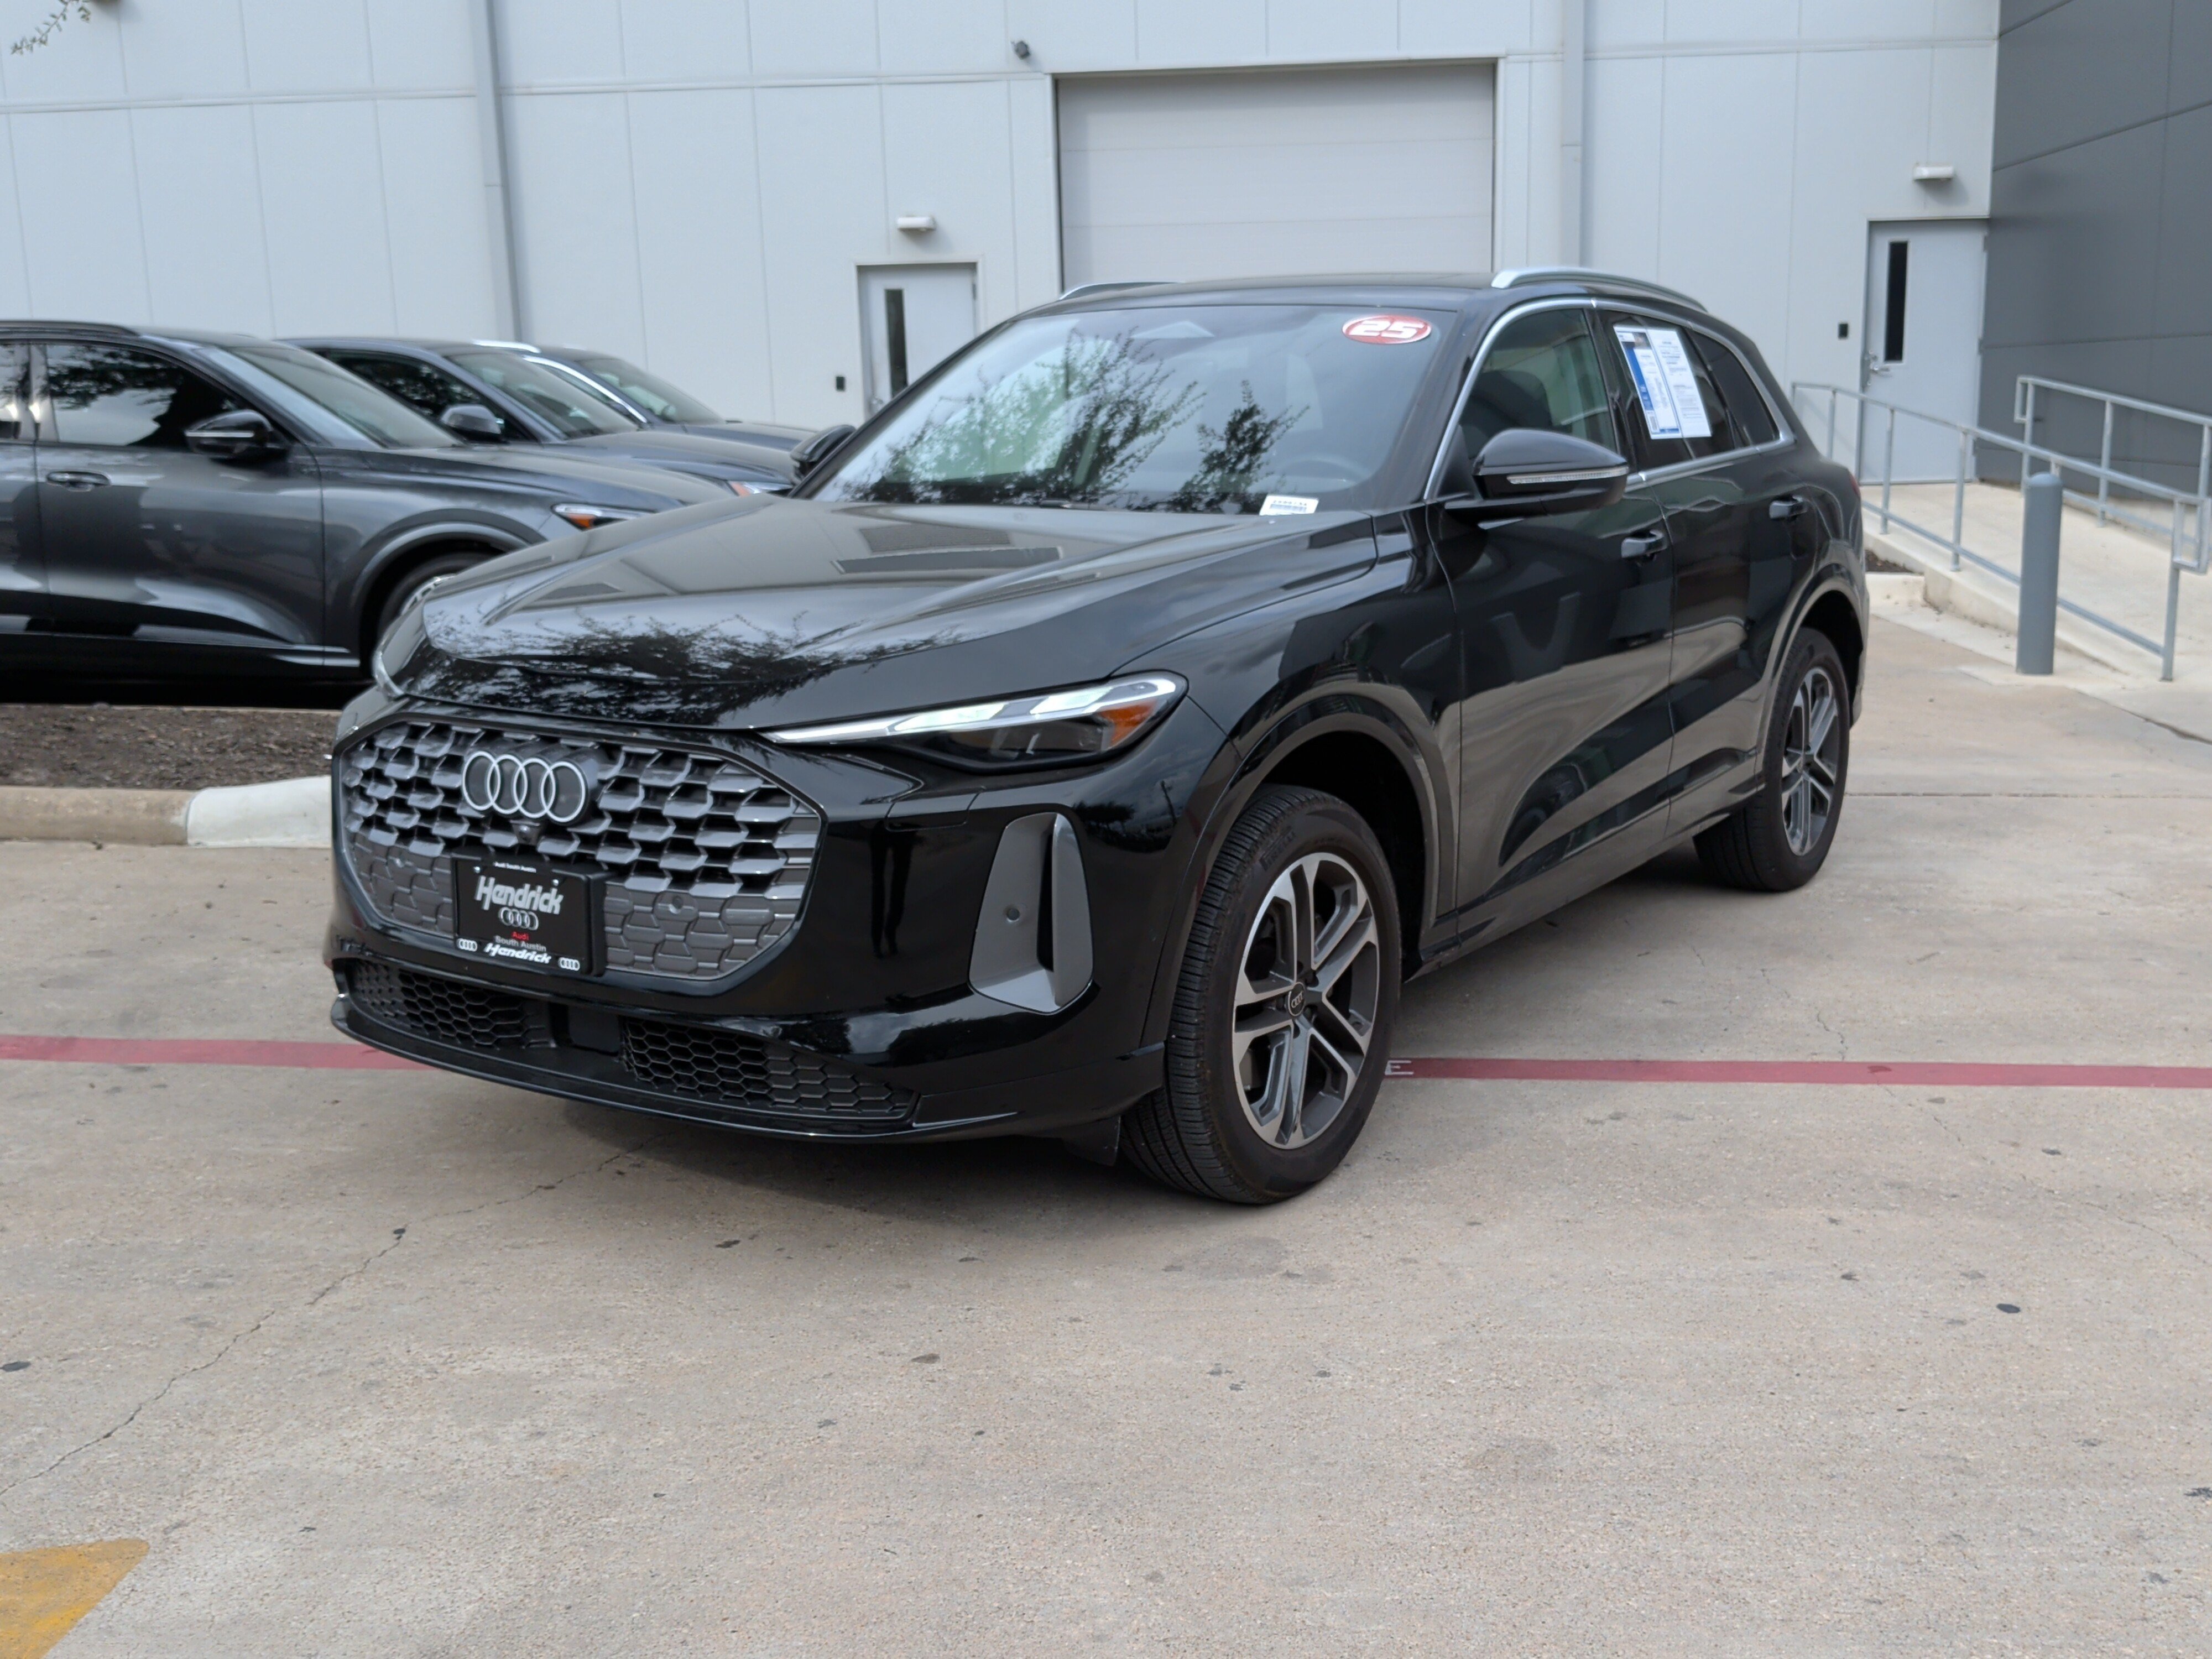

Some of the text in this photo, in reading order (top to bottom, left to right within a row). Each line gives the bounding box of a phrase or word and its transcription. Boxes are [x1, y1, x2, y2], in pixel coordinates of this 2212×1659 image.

[1348, 320, 1425, 339] 25
[474, 875, 564, 915] Hendrick
[494, 936, 546, 952] South Austin
[511, 932, 529, 941] Audi
[483, 943, 551, 964] Hendrick
